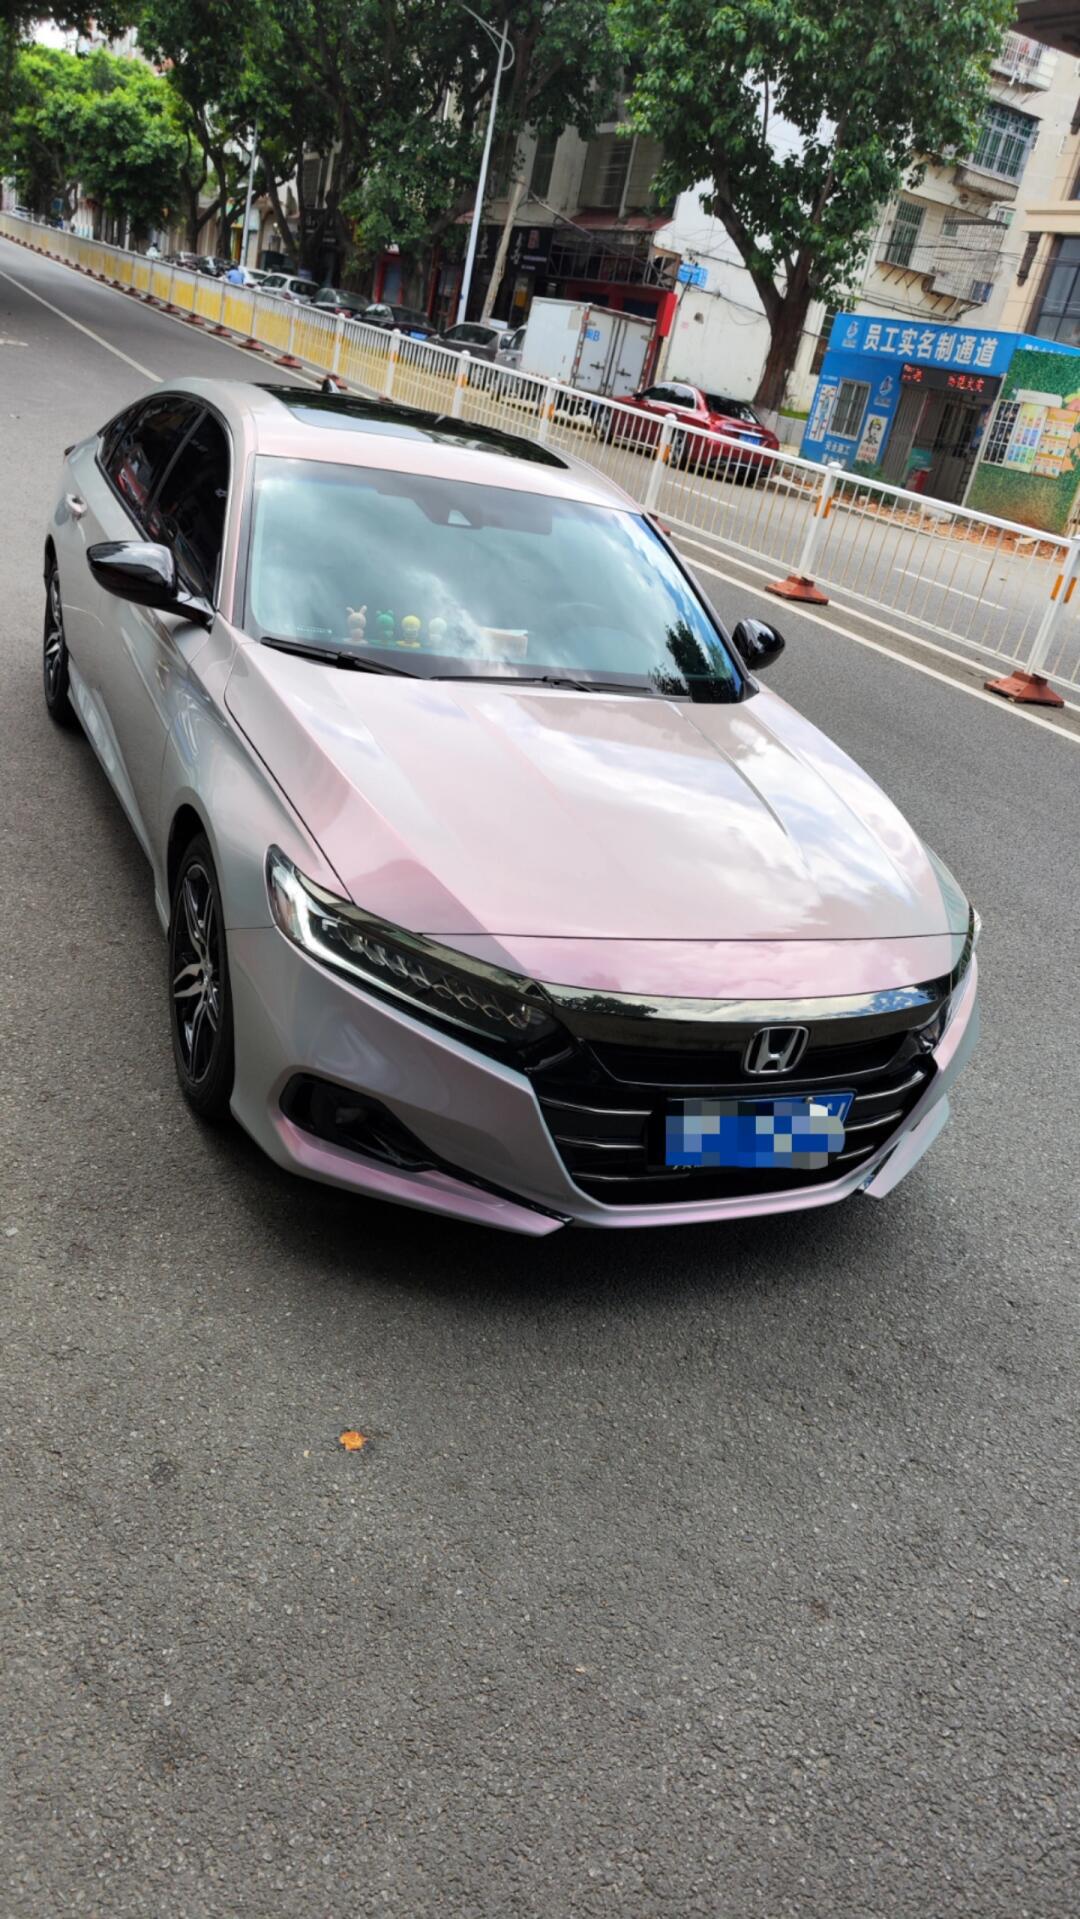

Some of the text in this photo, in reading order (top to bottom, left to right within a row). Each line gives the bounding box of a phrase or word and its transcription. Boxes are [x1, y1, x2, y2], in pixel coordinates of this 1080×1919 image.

[863, 324, 998, 367] 员工实名制通道
